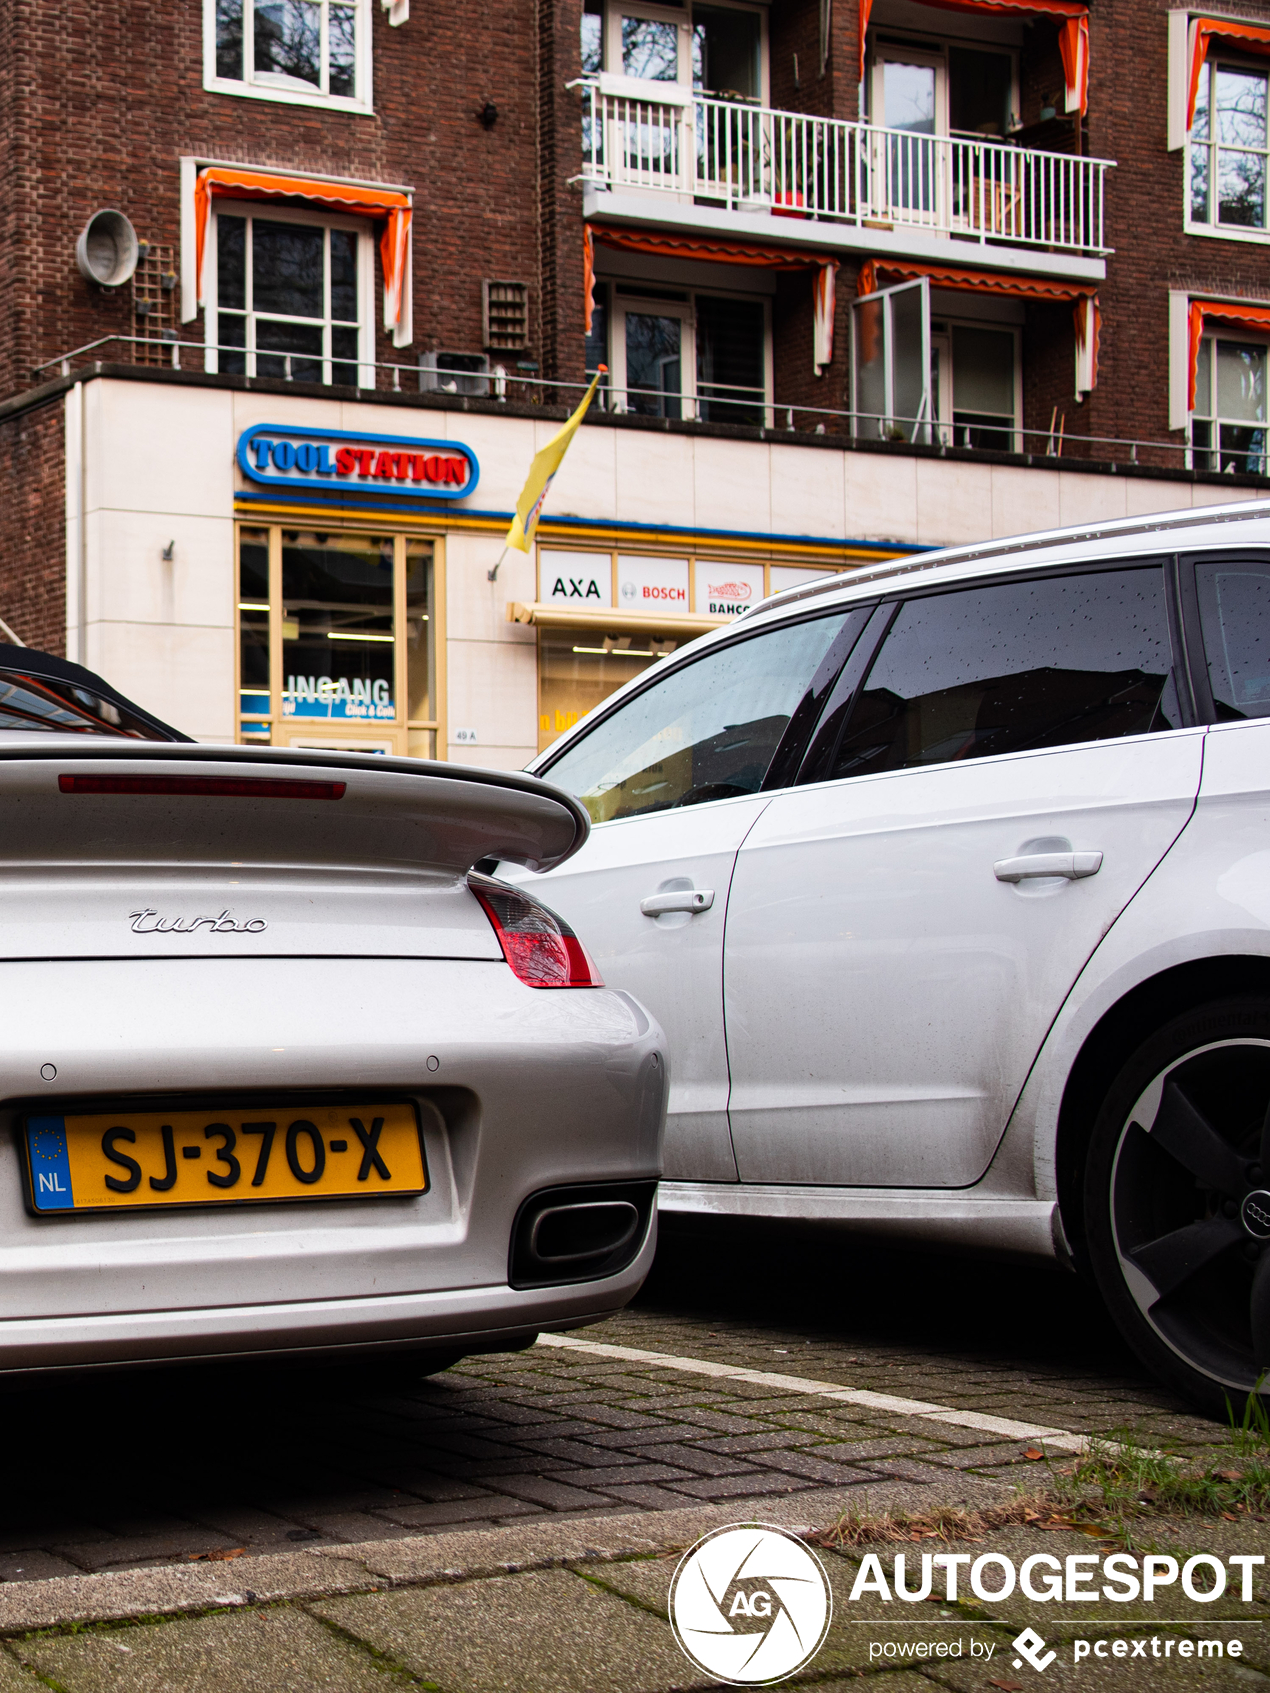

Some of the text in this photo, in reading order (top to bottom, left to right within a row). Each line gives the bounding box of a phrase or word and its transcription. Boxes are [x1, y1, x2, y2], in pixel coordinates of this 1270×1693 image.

[250, 438, 468, 485] TOOLSTATION
[552, 578, 600, 599] AXA
[642, 586, 686, 600] BOSCH
[288, 674, 390, 706] INGANG
[457, 731, 477, 741] 49 A
[101, 1116, 391, 1192] SJ-370-X
[38, 1173, 66, 1193] NL
